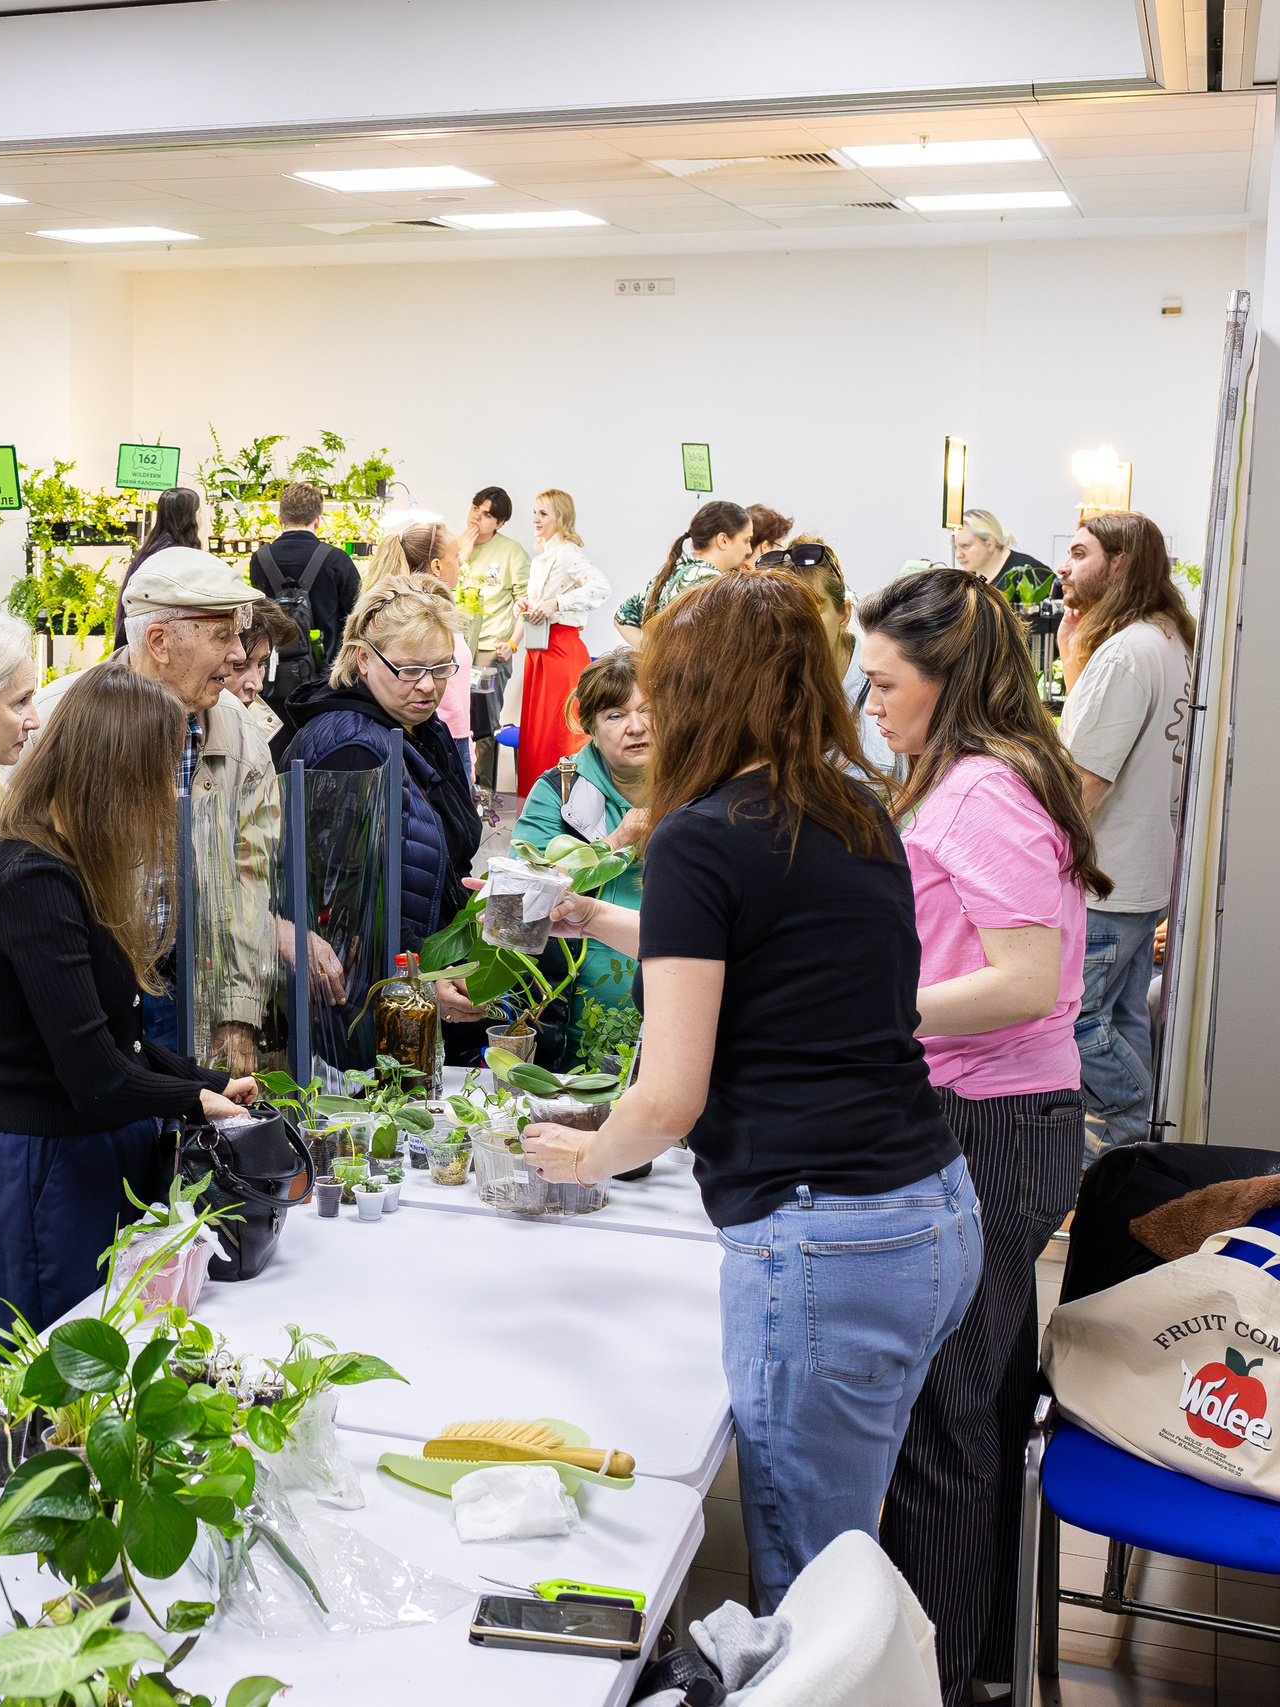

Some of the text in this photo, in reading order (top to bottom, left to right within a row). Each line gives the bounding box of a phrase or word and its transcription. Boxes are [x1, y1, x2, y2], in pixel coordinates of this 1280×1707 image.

[138, 453, 157, 465] 162
[1152, 1314, 1227, 1350] FRUIT
[1205, 1446, 1227, 1460] STORES
